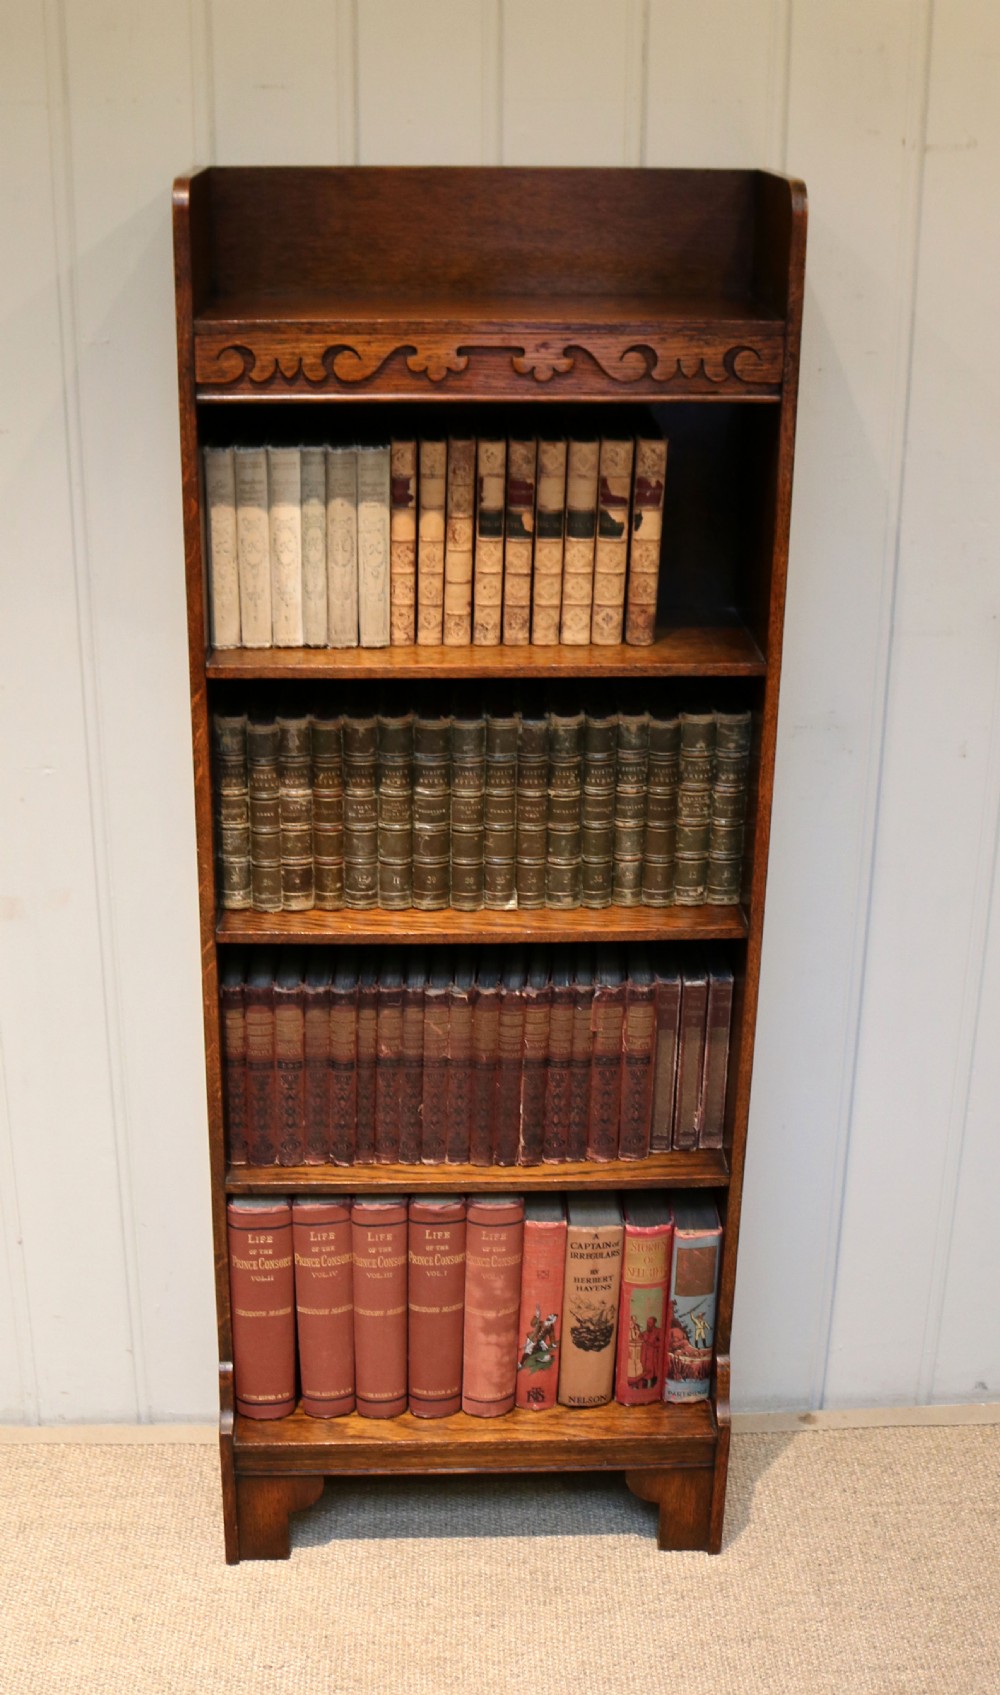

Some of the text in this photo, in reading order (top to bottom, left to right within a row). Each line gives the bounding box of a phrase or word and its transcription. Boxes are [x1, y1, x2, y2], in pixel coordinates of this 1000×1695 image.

[248, 1234, 274, 1244] LIFE
[310, 1231, 336, 1241] LIFE
[367, 1231, 393, 1242] LIFE
[425, 1230, 450, 1239] LIFE
[481, 1230, 507, 1240] LIFE
[570, 1241, 611, 1250] CAPTAIN
[409, 1250, 434, 1266] PRINCE
[570, 1248, 620, 1260] IRREGULARS
[232, 1254, 292, 1270] PRINCE CONSORT
[294, 1252, 321, 1268] PRINCE
[573, 1274, 614, 1283] HERBERT
[576, 1284, 612, 1292] HAVENS
[568, 1394, 608, 1404] NELSON
